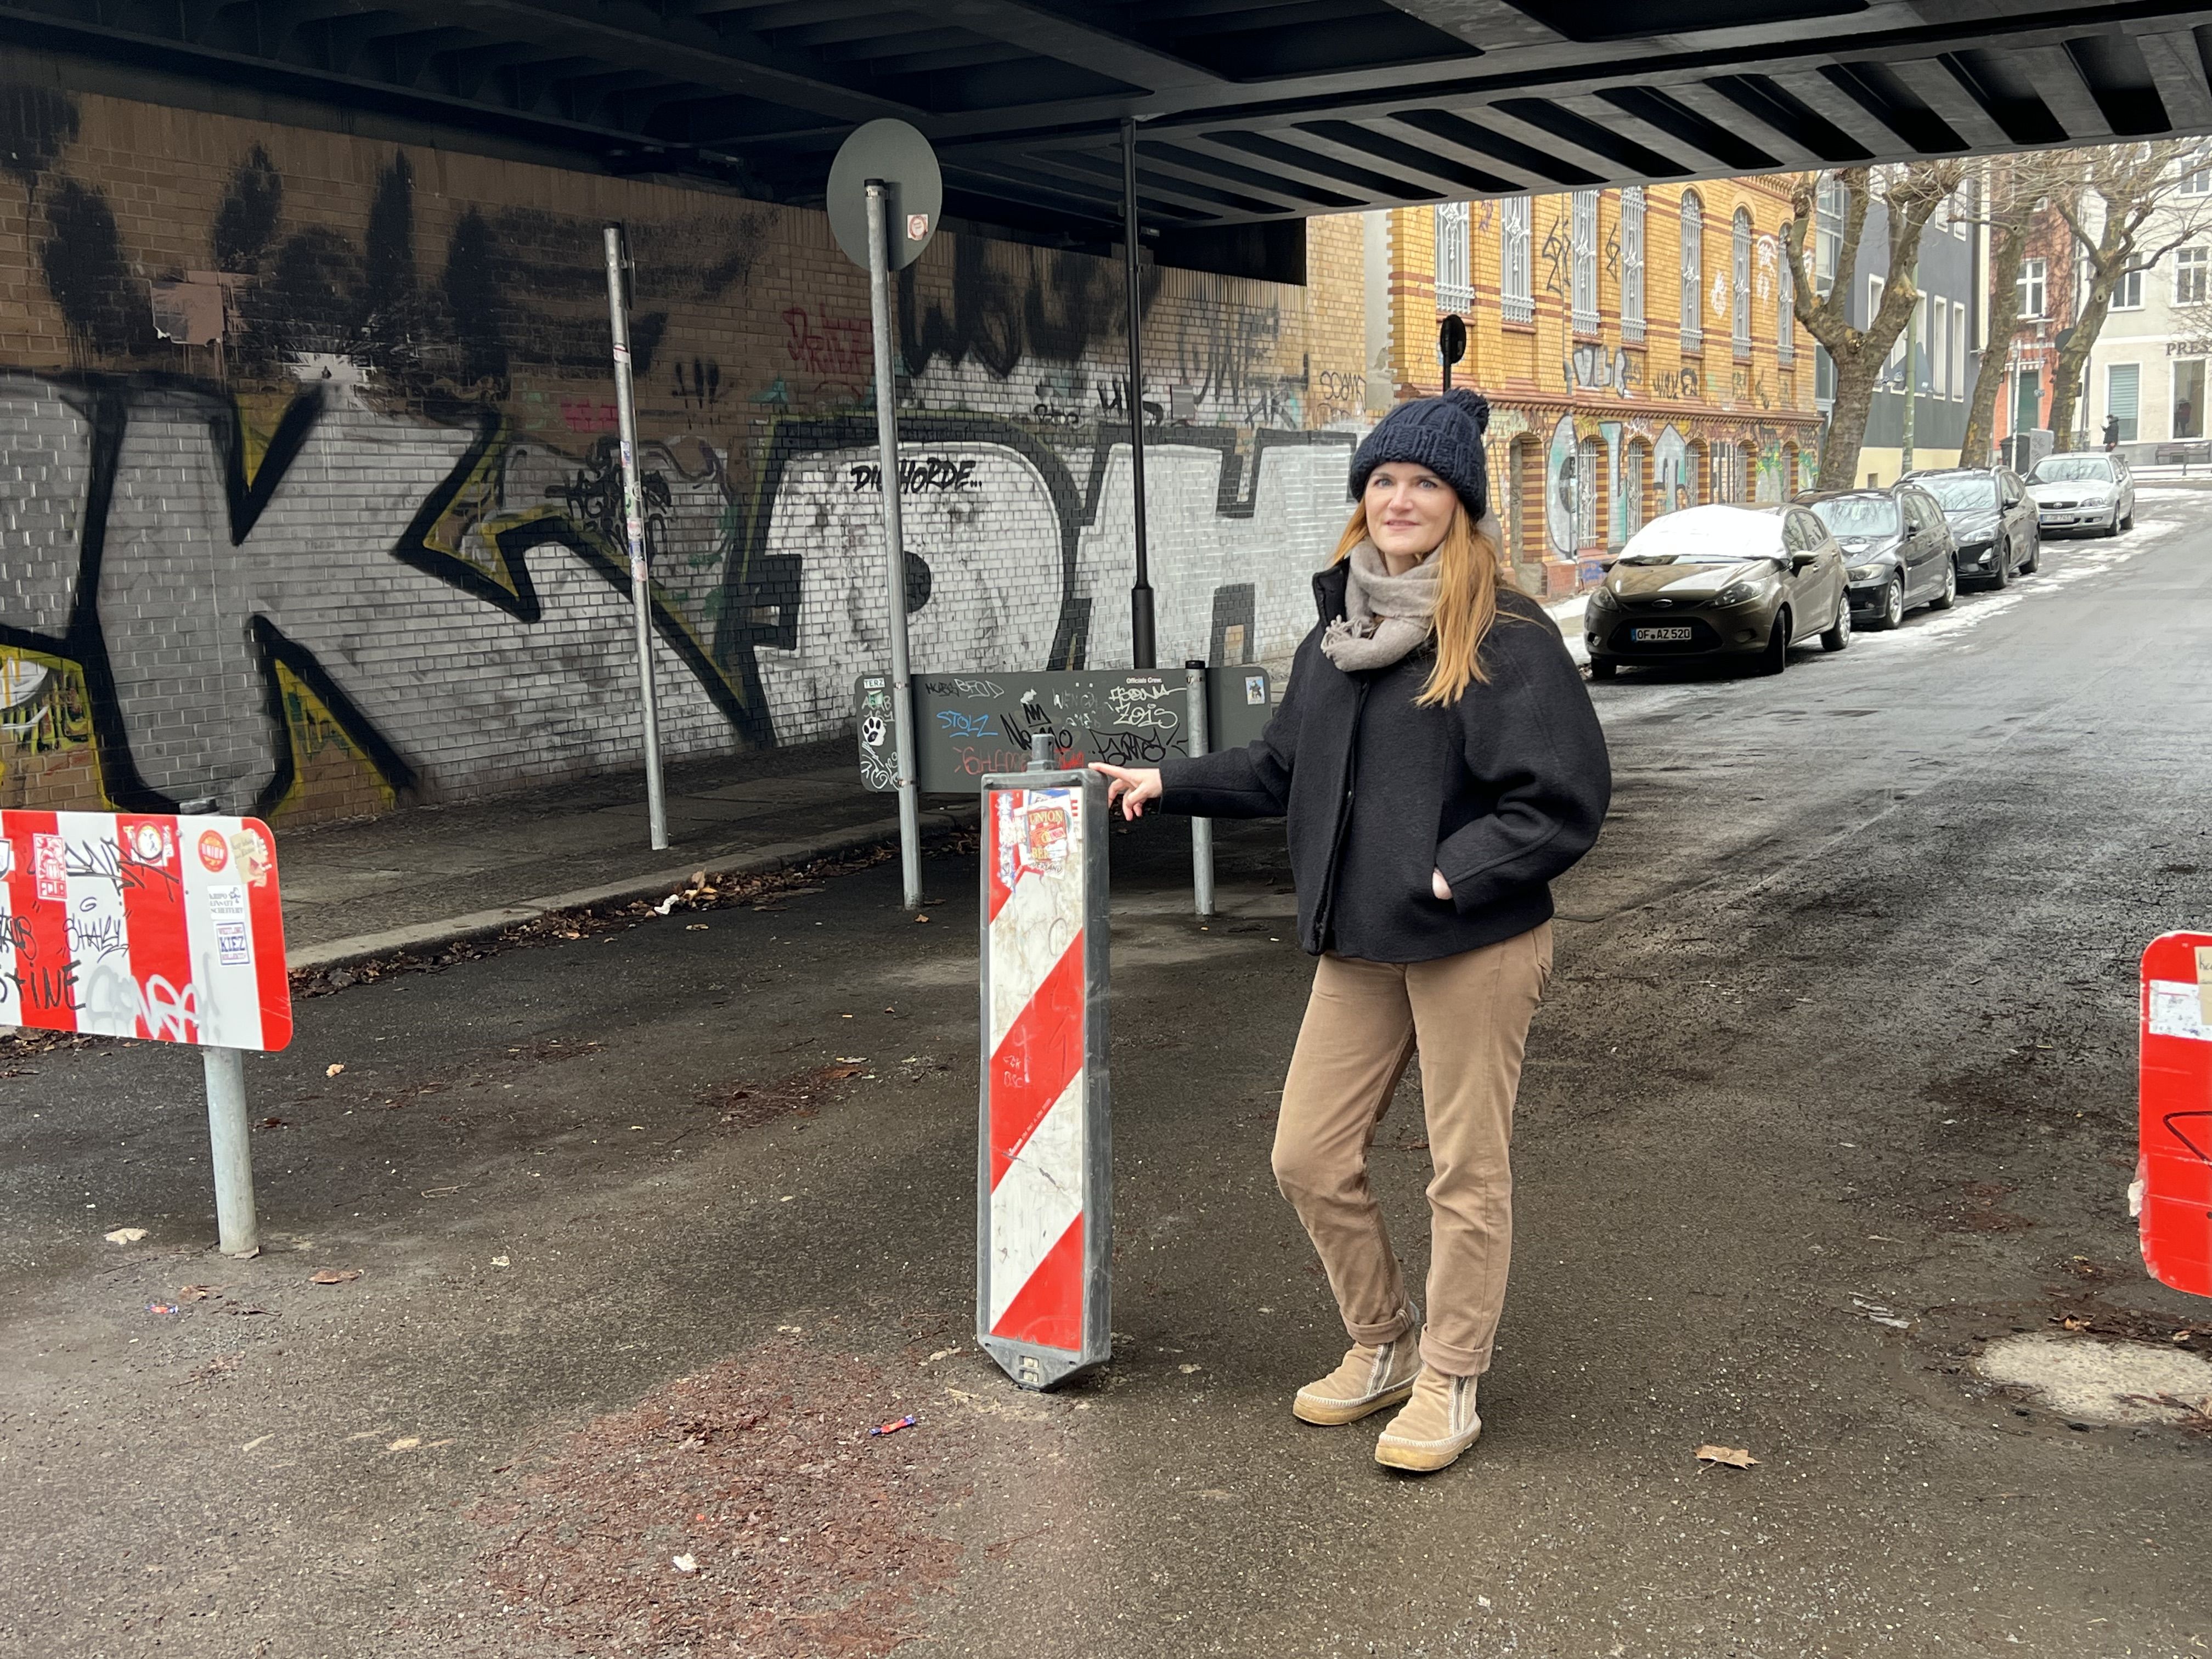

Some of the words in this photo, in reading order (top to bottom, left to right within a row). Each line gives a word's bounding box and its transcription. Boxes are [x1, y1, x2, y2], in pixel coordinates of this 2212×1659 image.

[1637, 629, 1650, 640] OF
[1656, 629, 1669, 640] AZ
[1671, 629, 1690, 639] 520
[936, 710, 998, 738] STOLZ
[1030, 809, 1063, 825] UNION
[219, 936, 246, 952] KIEZ
